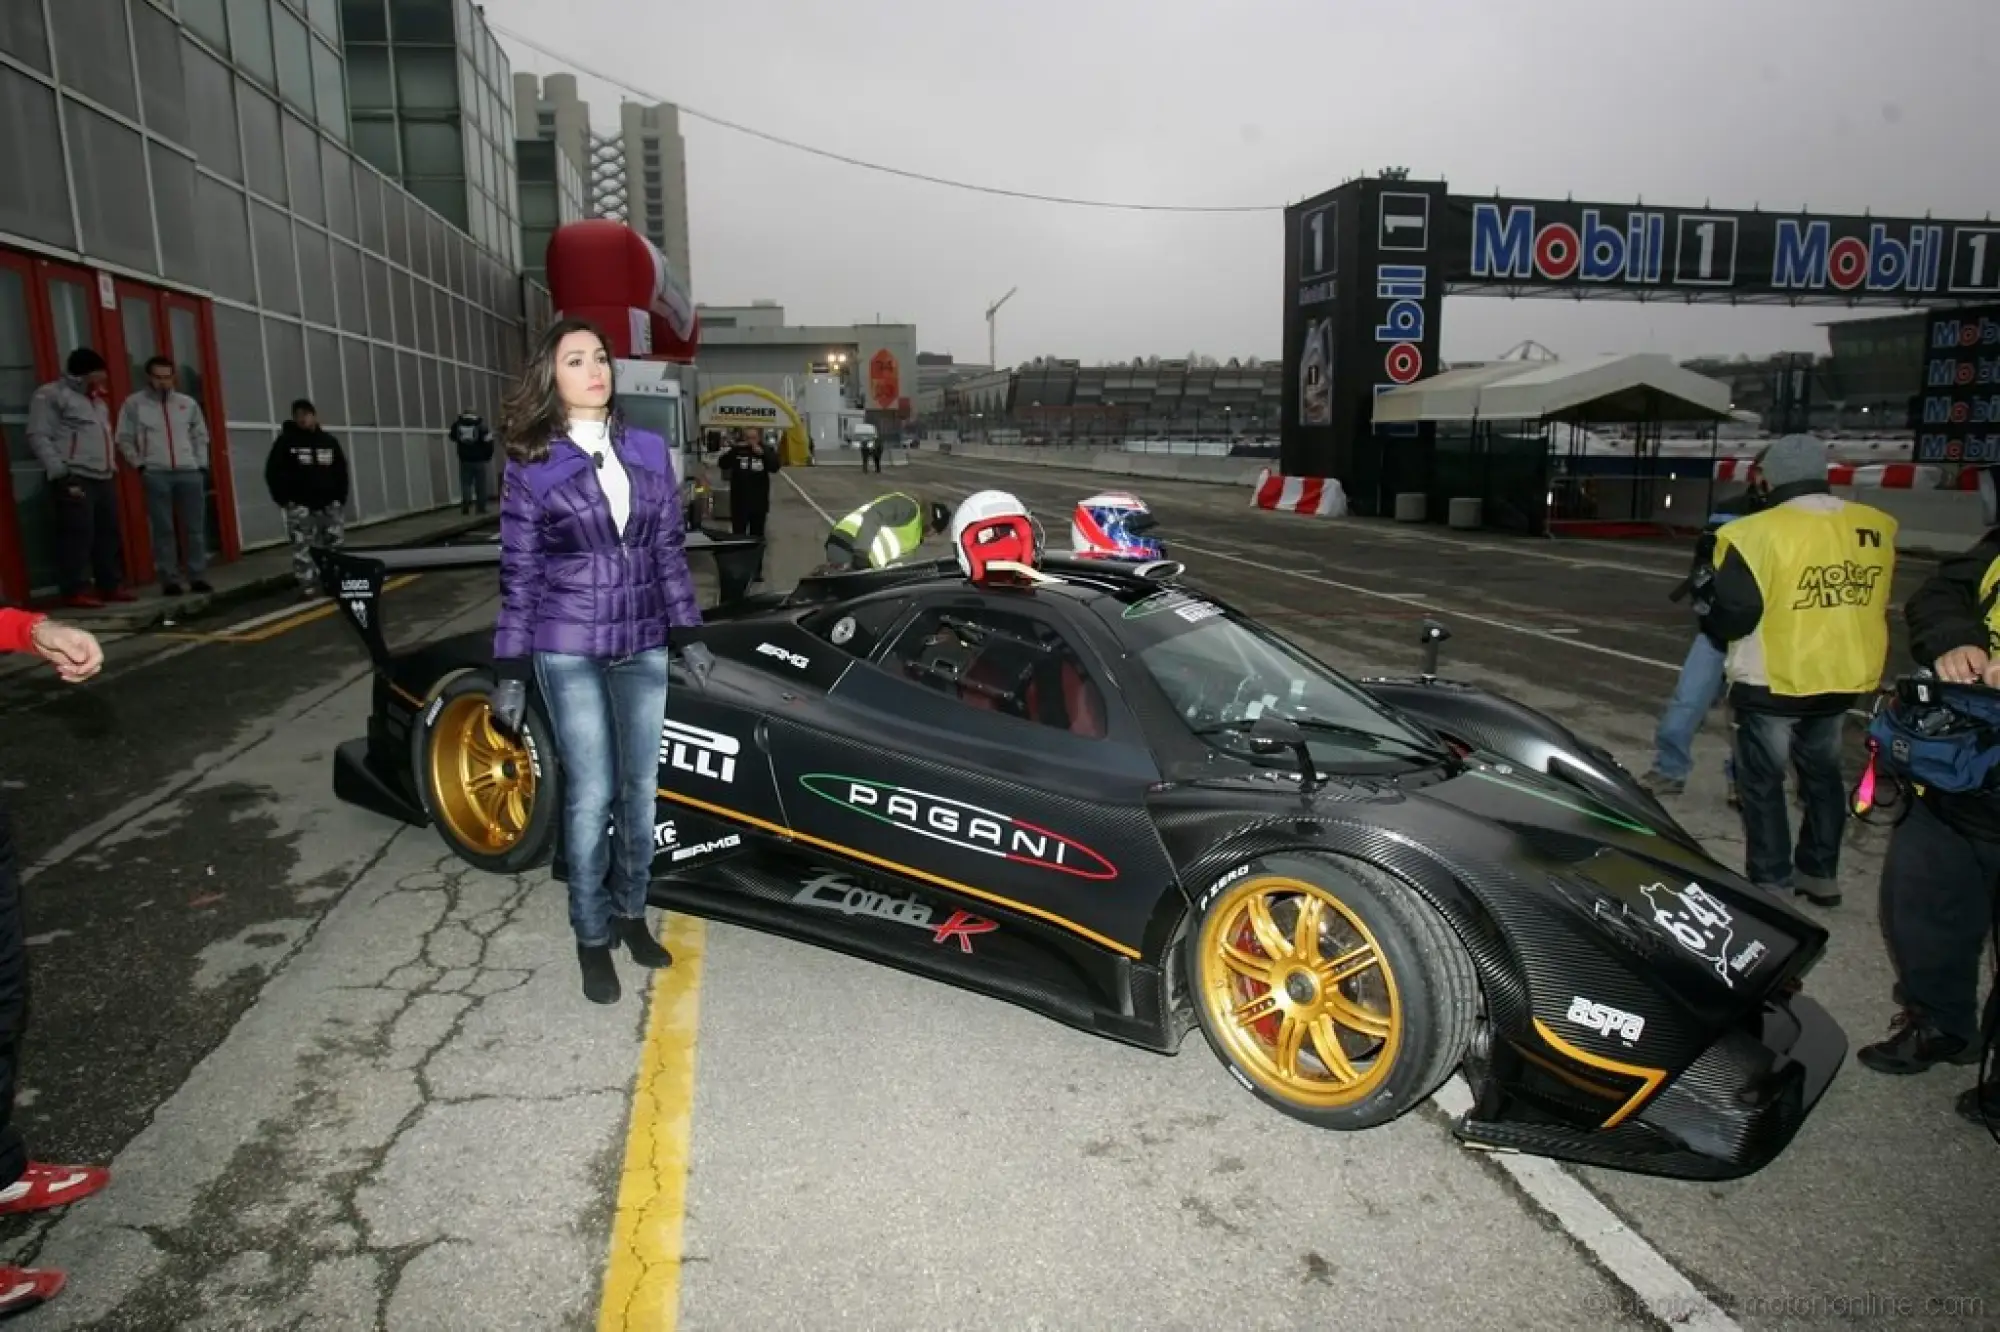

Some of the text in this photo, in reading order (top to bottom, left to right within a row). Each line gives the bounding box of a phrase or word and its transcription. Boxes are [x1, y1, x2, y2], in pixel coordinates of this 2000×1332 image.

[1310, 211, 1324, 273] 1
[1471, 203, 1716, 283] Mobil 1
[1771, 218, 1988, 292] Mobil 1
[689, 834, 741, 857] AMG
[850, 783, 1065, 864] PAGANI
[932, 907, 1000, 954] R
[1567, 995, 1645, 1042] aspa
